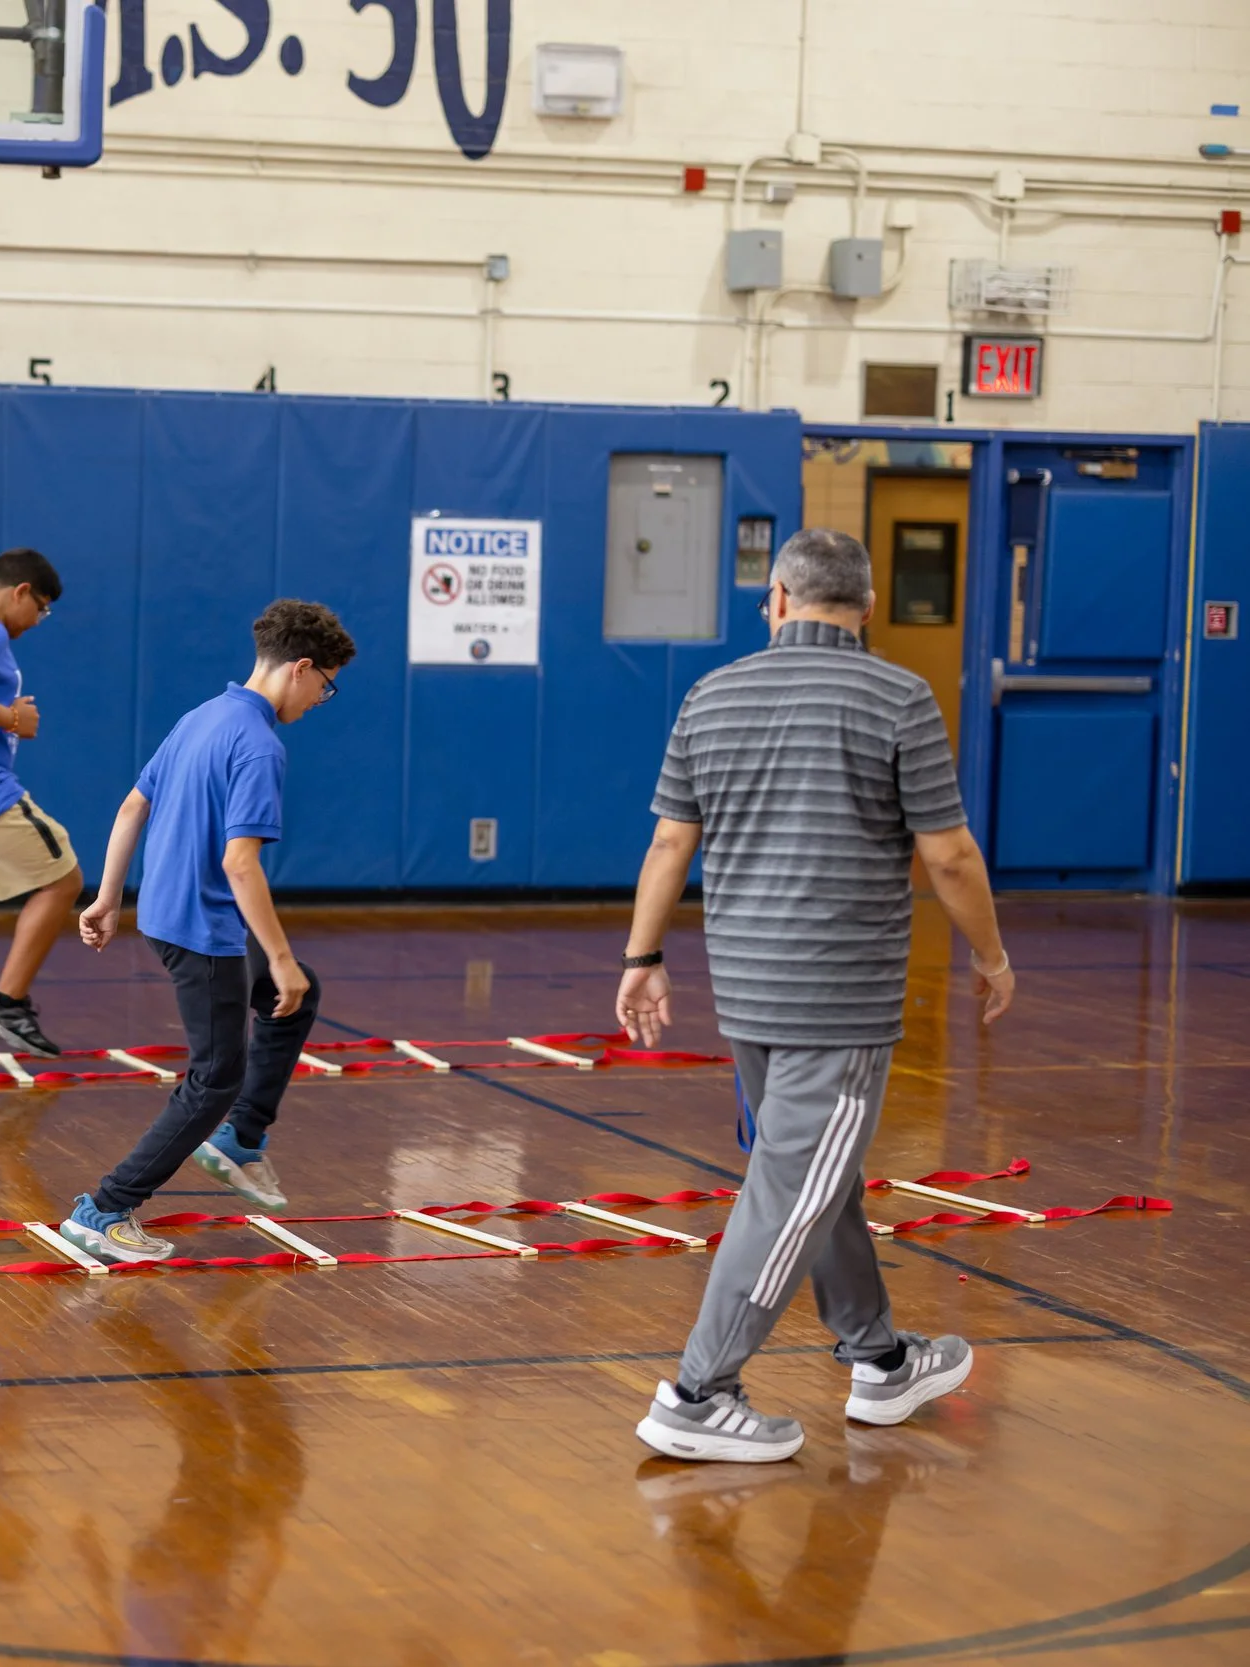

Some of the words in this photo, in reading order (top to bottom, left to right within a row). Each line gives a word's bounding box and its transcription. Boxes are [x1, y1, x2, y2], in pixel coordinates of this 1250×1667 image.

[29, 358, 52, 386] 5
[977, 343, 1038, 394] EXIT
[709, 379, 731, 408] 2
[428, 530, 528, 556] NOTICE
